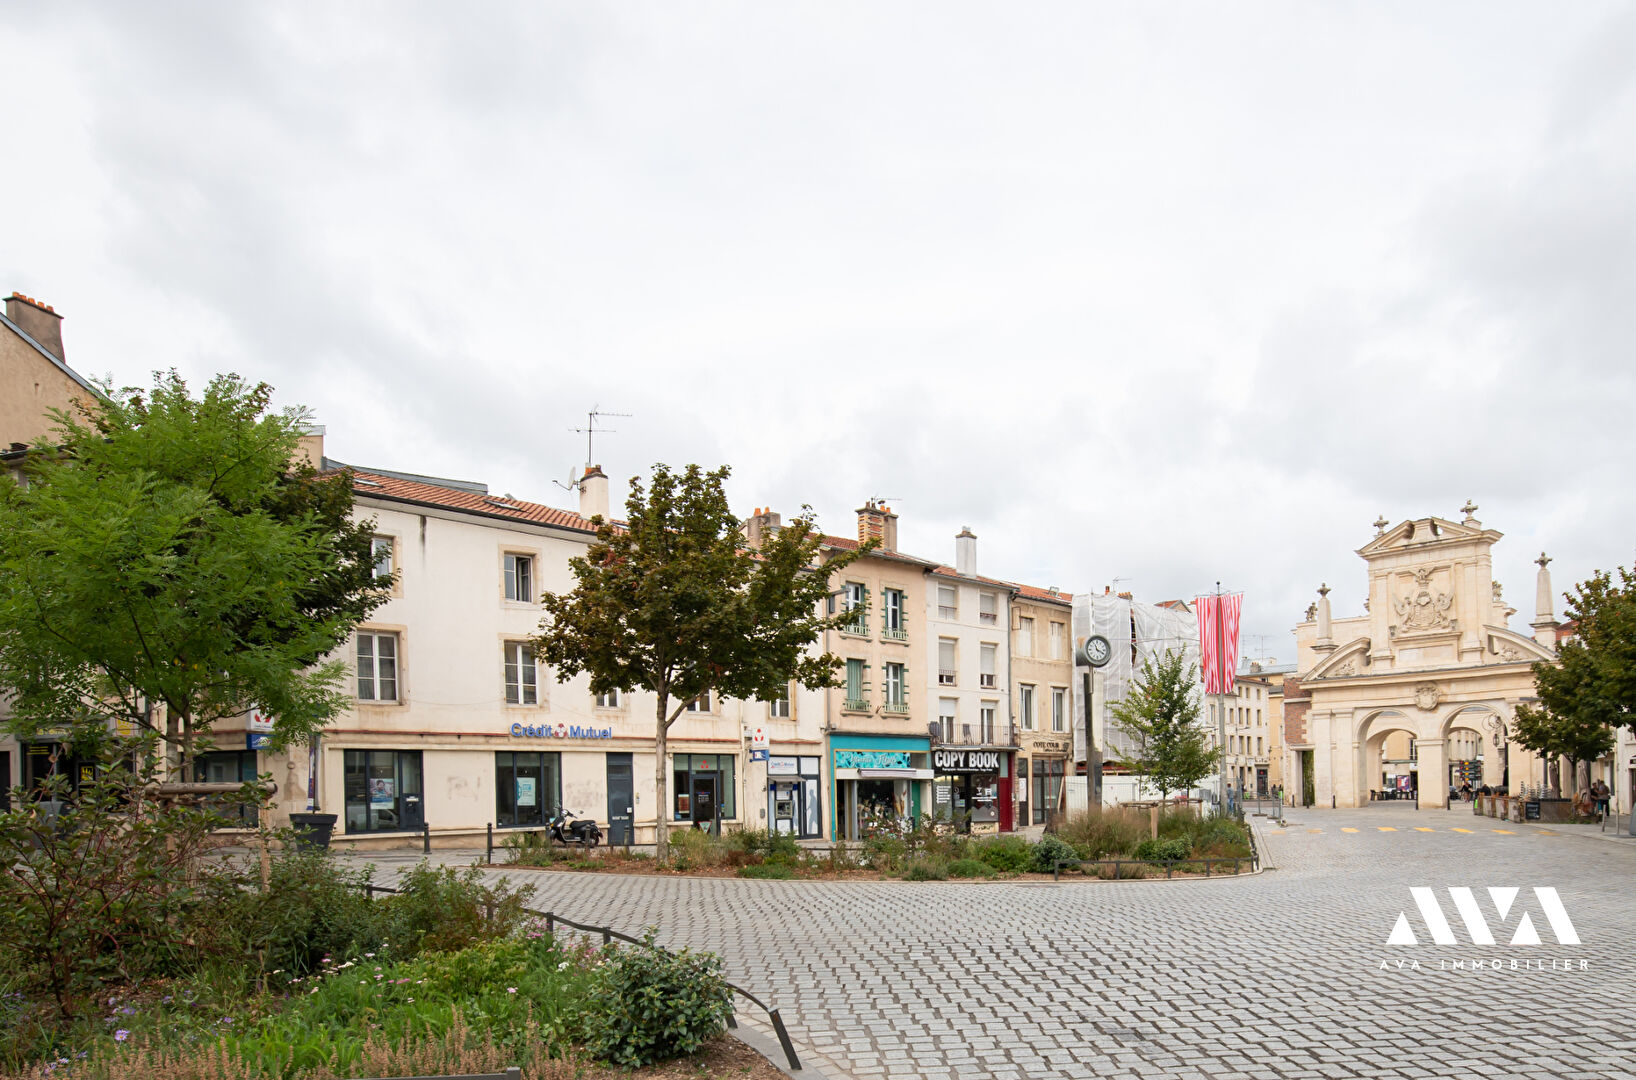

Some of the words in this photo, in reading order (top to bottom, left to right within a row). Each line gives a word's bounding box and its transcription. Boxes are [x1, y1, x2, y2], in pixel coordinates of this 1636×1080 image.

[511, 722, 552, 738] Crédit
[569, 725, 612, 739] Mutuel
[934, 751, 966, 768] COPY
[968, 752, 1000, 768] BOOK
